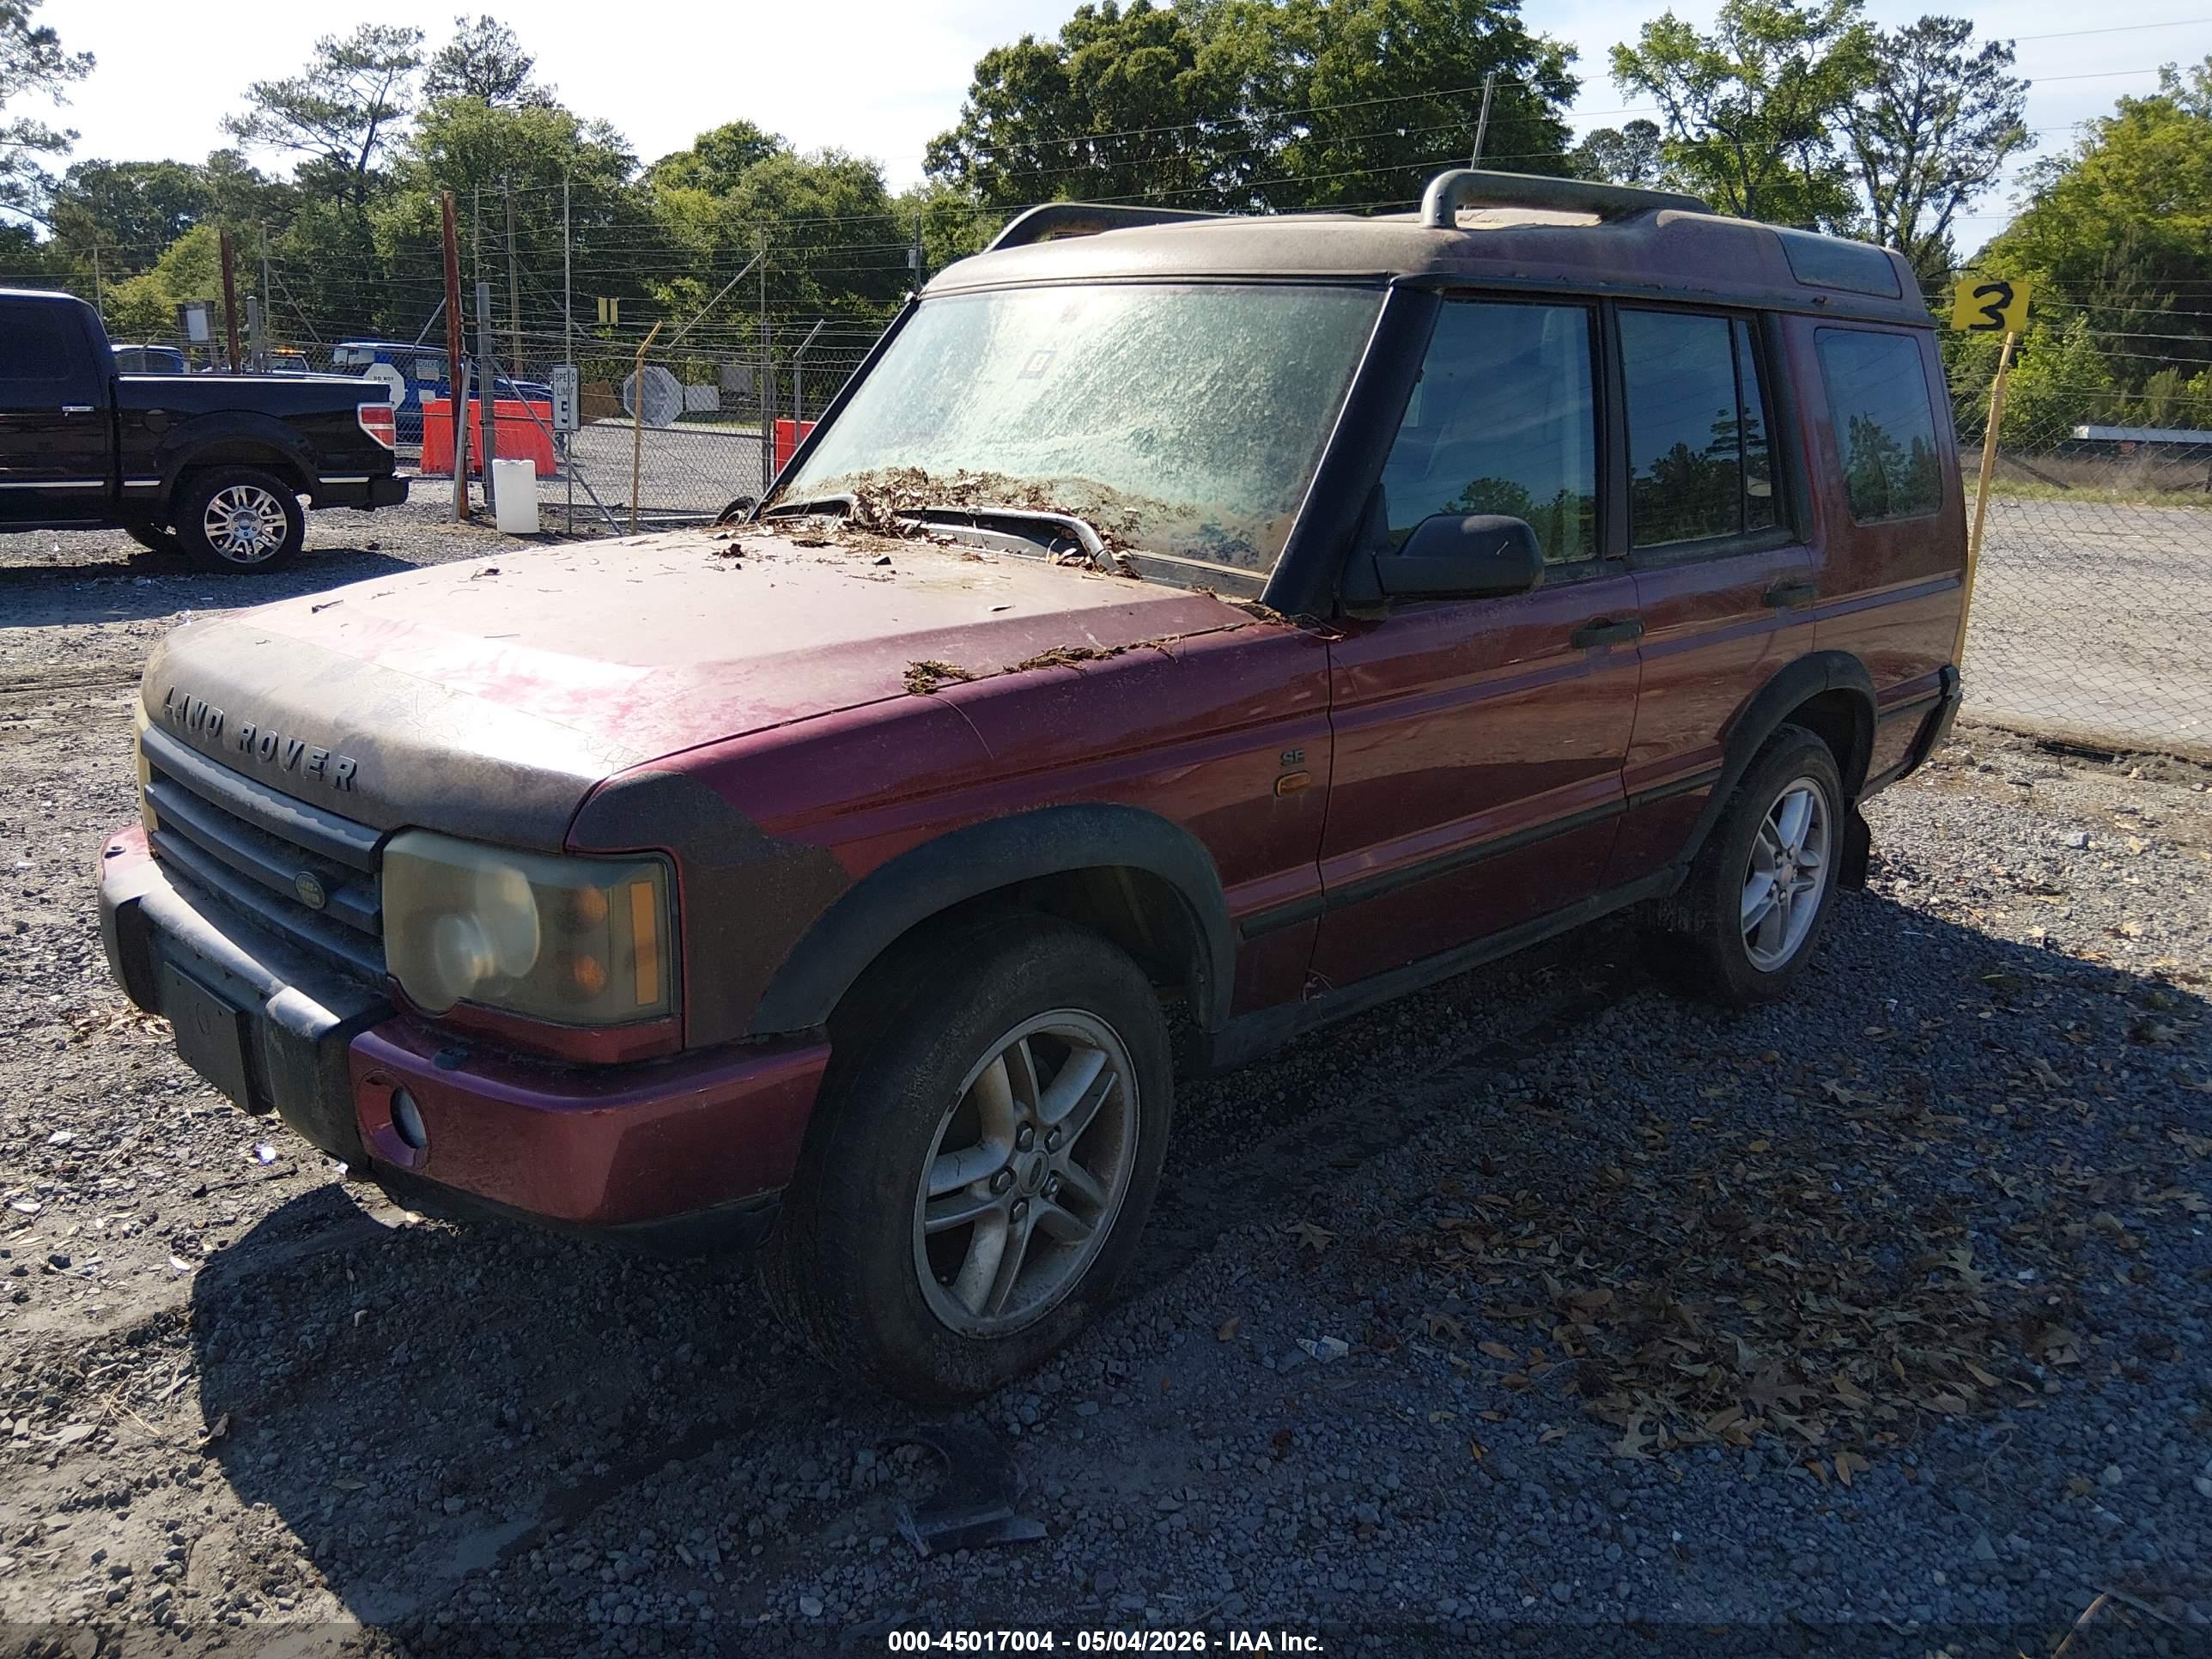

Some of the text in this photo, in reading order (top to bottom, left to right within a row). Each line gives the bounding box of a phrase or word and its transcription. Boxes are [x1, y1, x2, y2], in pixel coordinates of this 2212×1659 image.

[1969, 282, 2014, 331] 3
[556, 373, 576, 382] SPED
[164, 685, 358, 793] LAND ROVER
[1280, 749, 1305, 766] SE
